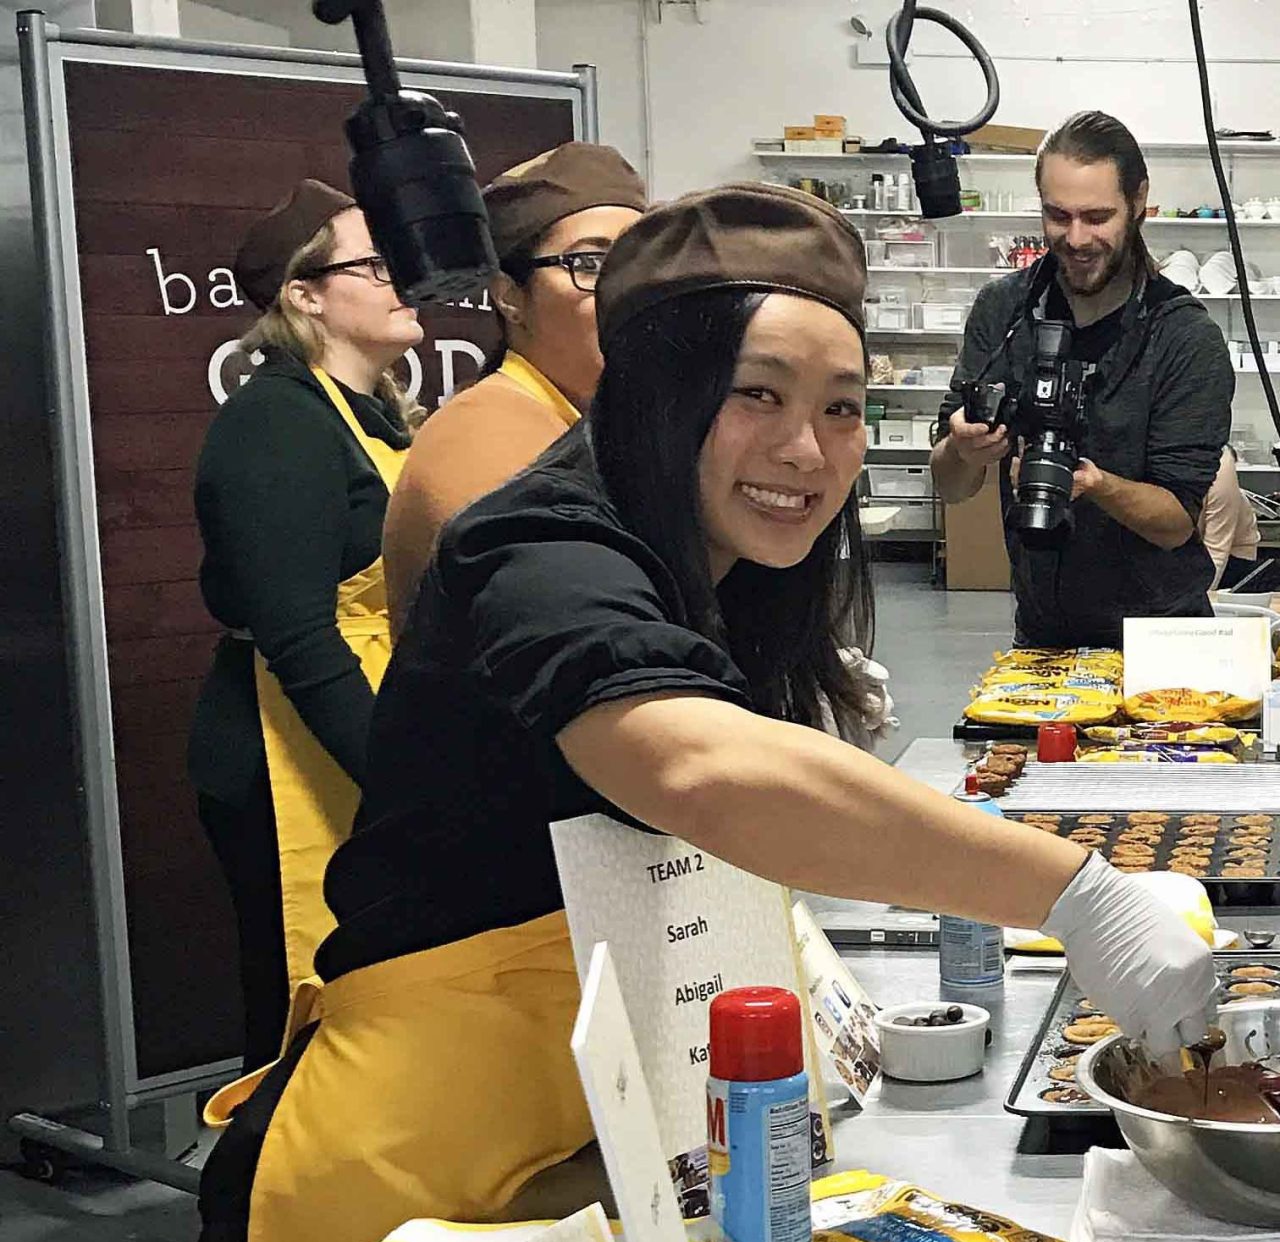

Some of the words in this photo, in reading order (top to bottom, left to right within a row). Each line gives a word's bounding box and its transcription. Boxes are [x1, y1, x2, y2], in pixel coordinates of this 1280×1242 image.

[646, 856, 692, 884] TEAM
[694, 853, 705, 872] 2
[667, 915, 709, 944] Sarah
[674, 972, 724, 1006] Abigail
